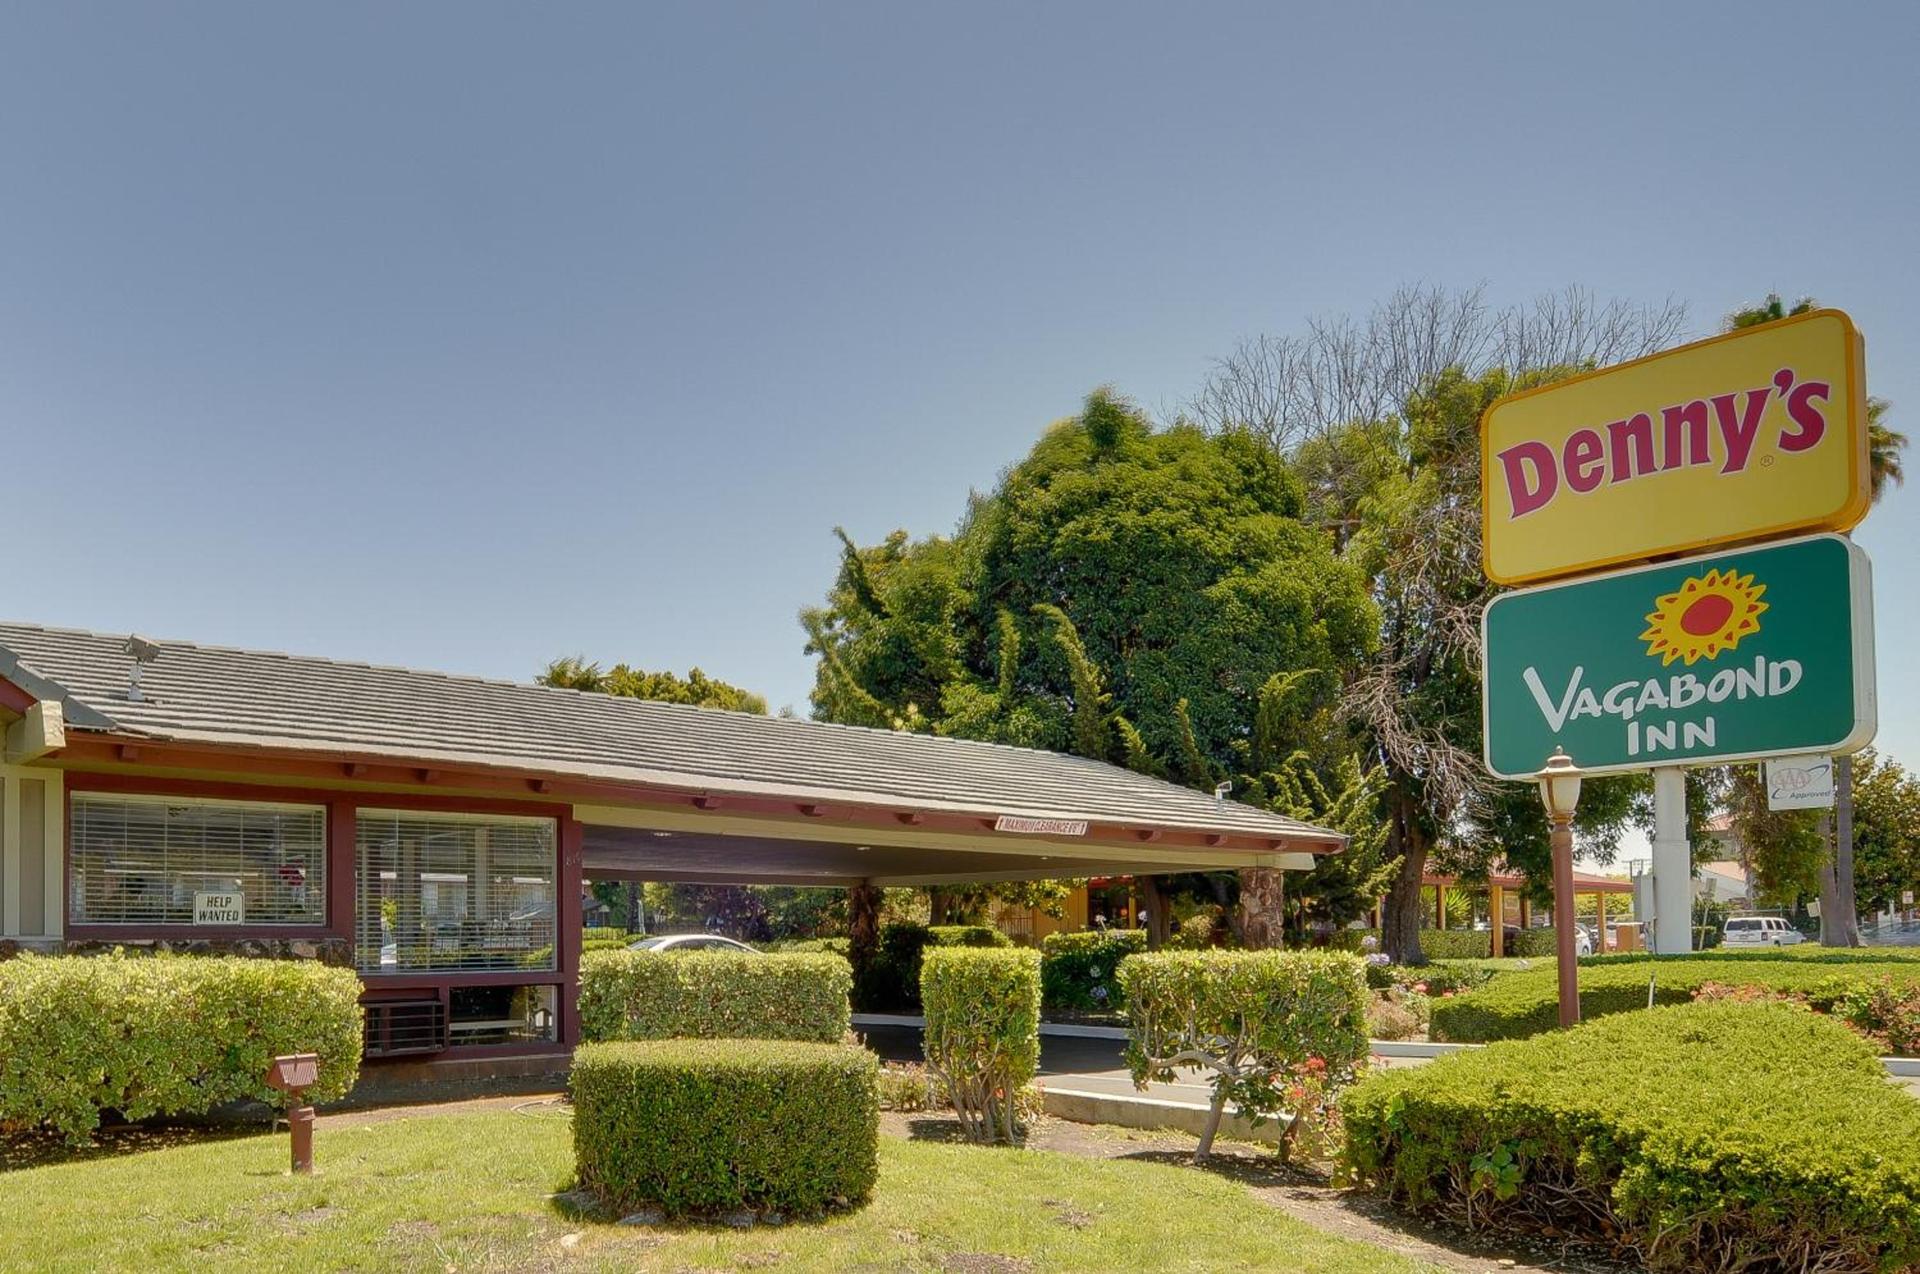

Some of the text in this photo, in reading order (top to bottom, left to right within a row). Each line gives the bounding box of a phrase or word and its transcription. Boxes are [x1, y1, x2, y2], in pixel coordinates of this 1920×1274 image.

[1496, 367, 1831, 520] Denny's
[1627, 716, 1716, 756] INN
[1790, 790, 1831, 799] Approved
[206, 896, 232, 908] HELP
[199, 910, 239, 921] WANTED
